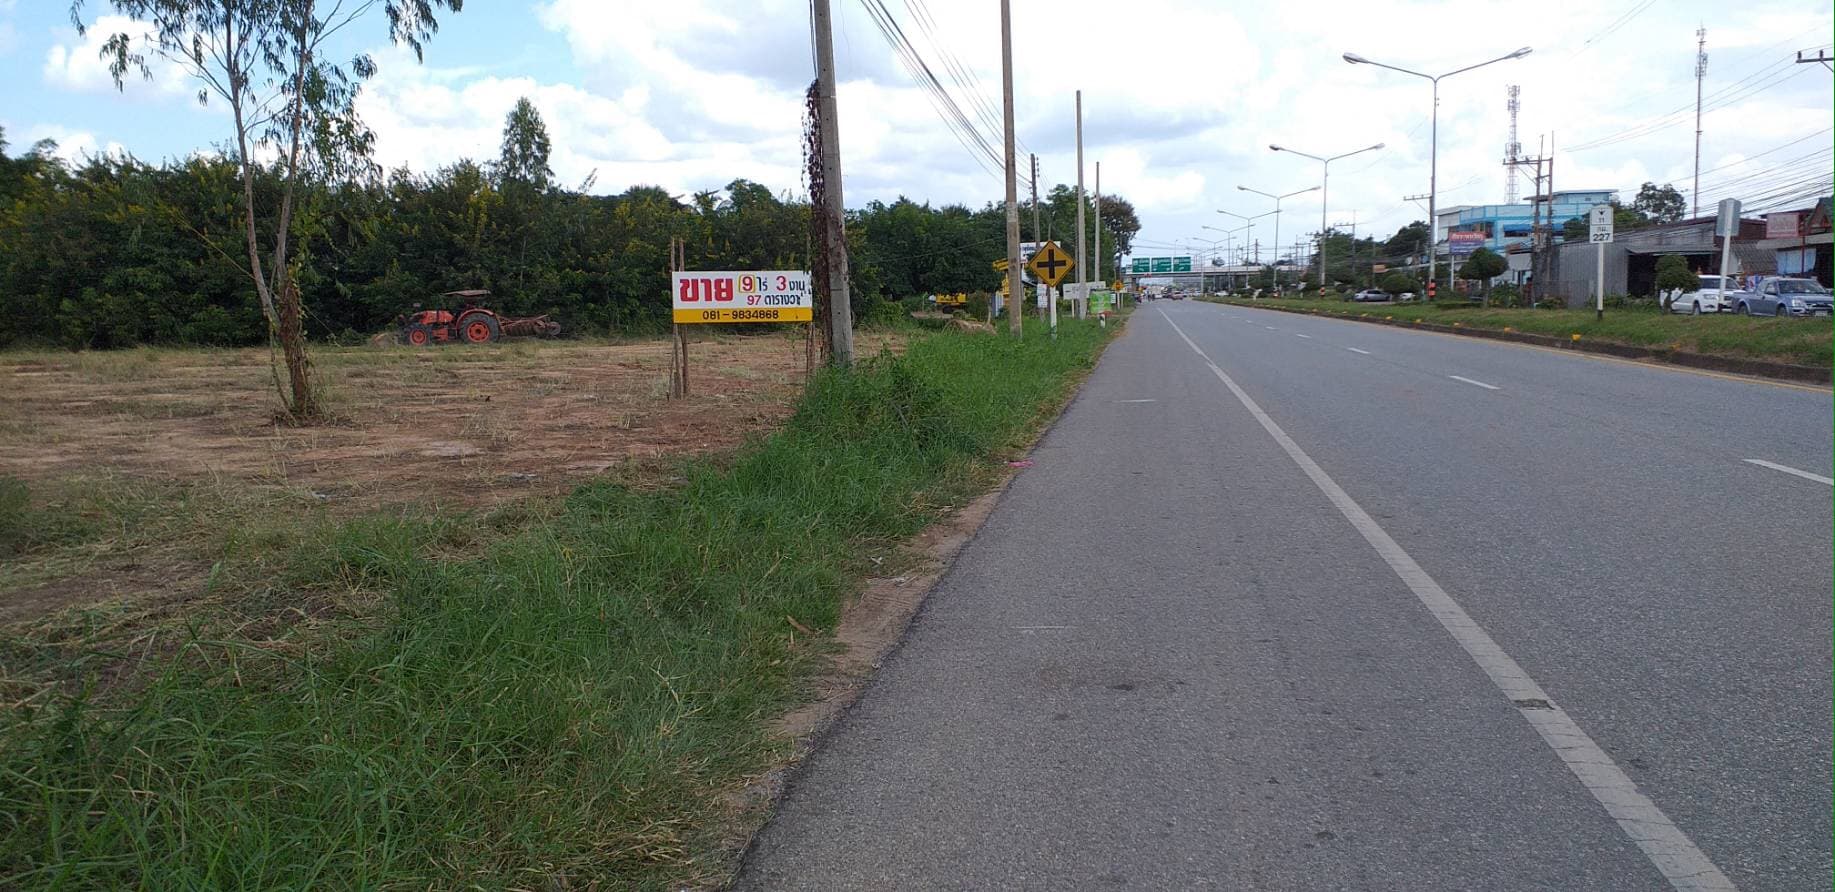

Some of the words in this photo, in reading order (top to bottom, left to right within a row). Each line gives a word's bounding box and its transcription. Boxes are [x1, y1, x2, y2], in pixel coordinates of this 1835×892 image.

[1593, 233, 1610, 242] 227
[679, 278, 733, 302] ขาย
[742, 276, 753, 292] 9
[756, 276, 768, 292] ไร่
[775, 275, 787, 292] 3
[788, 280, 805, 292] งาน
[747, 294, 762, 306] 97
